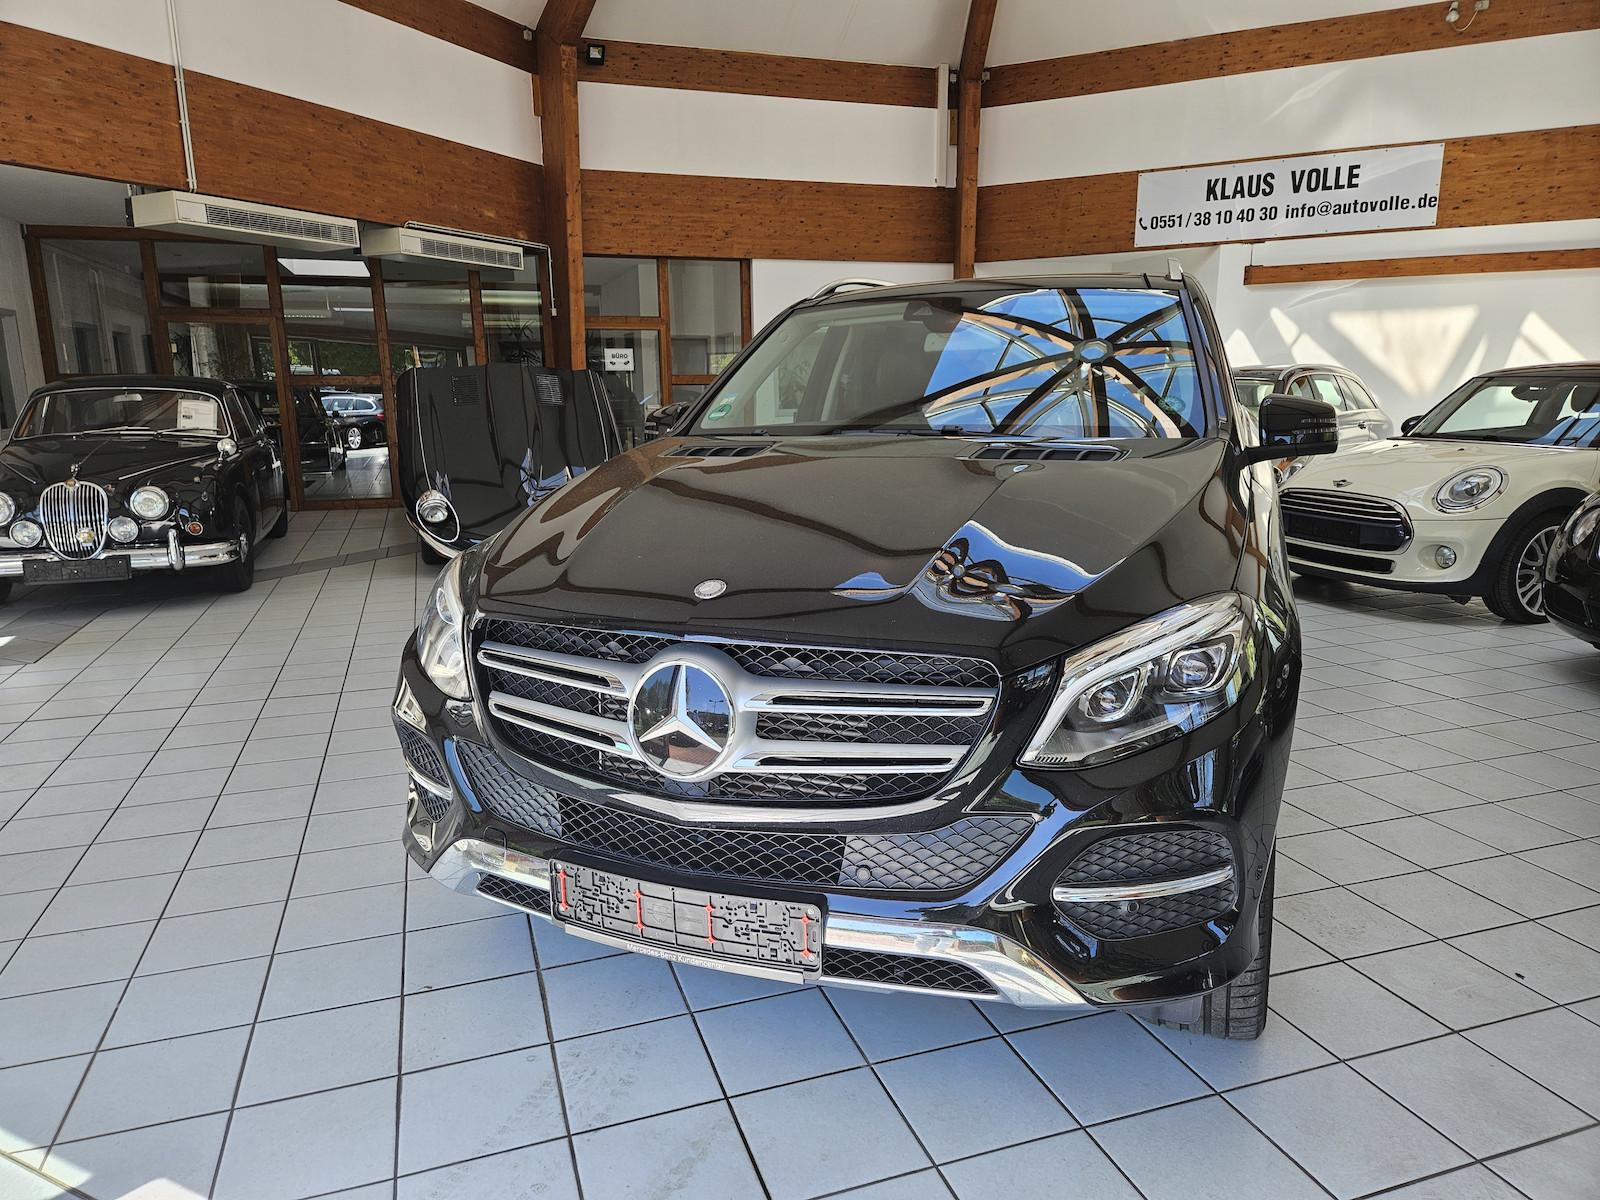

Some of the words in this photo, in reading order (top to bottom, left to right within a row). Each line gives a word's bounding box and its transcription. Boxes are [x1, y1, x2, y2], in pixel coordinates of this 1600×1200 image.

[1206, 172, 1275, 201] KLAUS
[1291, 164, 1361, 193] VOLLE
[1215, 210, 1232, 225] 10
[1236, 207, 1255, 223] 40
[1259, 206, 1278, 221] 30
[1285, 193, 1438, 219] info@autovolle.de
[627, 943, 676, 960] Mercedes-Benz
